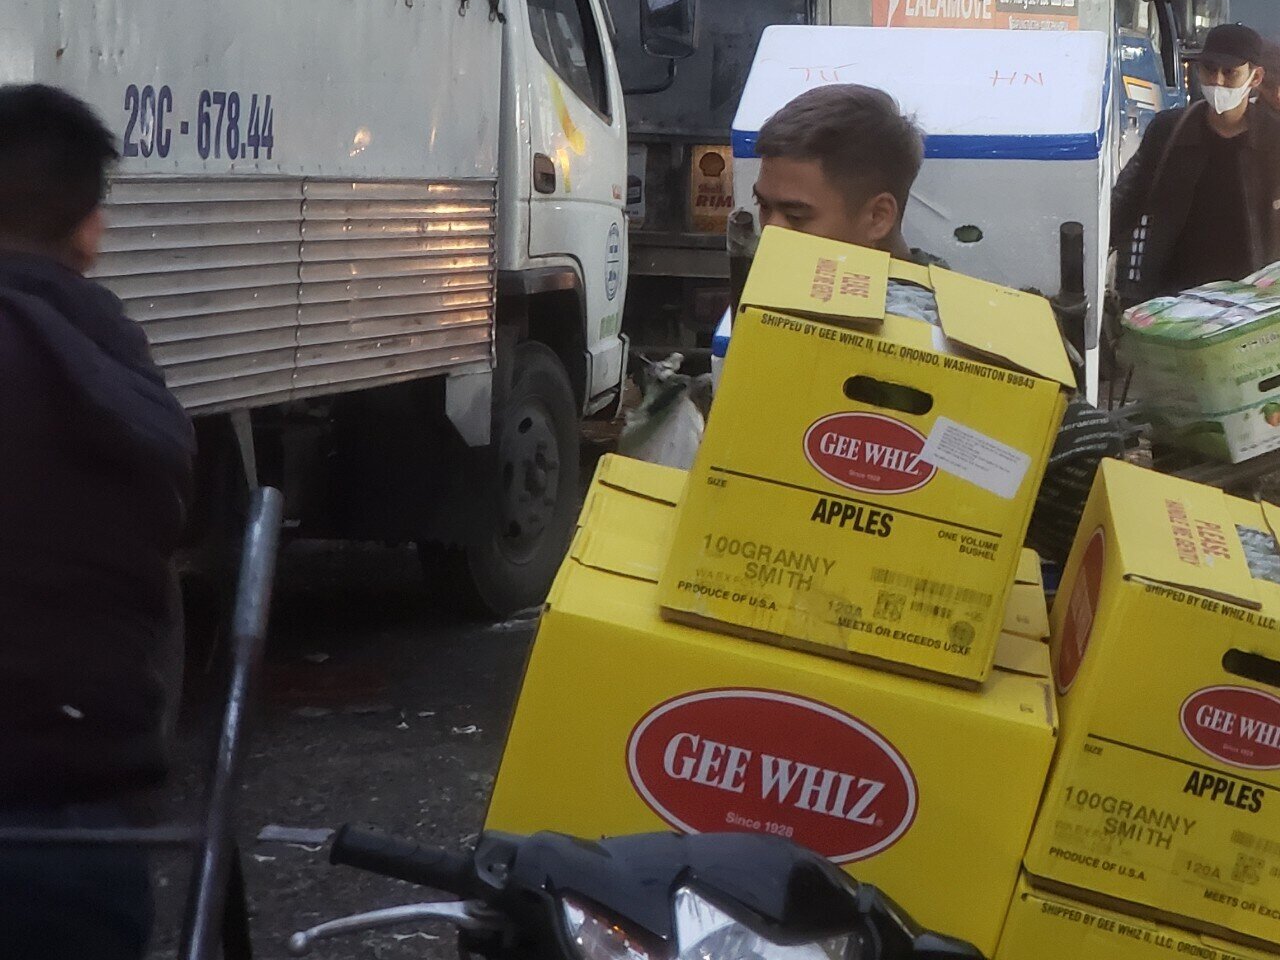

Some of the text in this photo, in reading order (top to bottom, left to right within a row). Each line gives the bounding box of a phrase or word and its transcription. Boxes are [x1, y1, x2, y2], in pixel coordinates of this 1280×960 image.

[197, 89, 274, 160] 678.44
[761, 313, 803, 332] SHIPPED
[804, 324, 818, 336] BY
[819, 327, 838, 341] GEE
[840, 332, 864, 348] WHIZ
[943, 356, 1007, 383] WASHINGTON
[819, 431, 862, 462] GEE
[864, 441, 922, 476] WHIZ
[707, 476, 728, 488] SIZE
[810, 498, 895, 538] APPLES
[703, 533, 837, 576] 100GRANNY
[937, 530, 999, 552] ONE VOLUME
[958, 544, 997, 561] BUSHEL
[677, 580, 730, 600] PRODUCE
[731, 592, 747, 603] OF
[744, 561, 814, 591] SMITH
[1145, 584, 1186, 603] SHIPPED
[1186, 595, 1200, 607] BY
[1201, 599, 1220, 613] GEE
[1222, 604, 1245, 621] WHIZ
[837, 617, 872, 634] MEETS
[874, 626, 891, 638] OR
[892, 630, 941, 649] EXCEEDS
[1195, 704, 1238, 735] GEE
[663, 732, 886, 825] GEE WHIZ
[1183, 770, 1265, 814] APPLES
[725, 811, 794, 838] Since 1928
[1065, 786, 1197, 836] 100GRANNY
[1103, 817, 1173, 850] SMITH
[1049, 846, 1101, 869] PRODUCE
[1101, 861, 1117, 872] OF
[1203, 890, 1240, 908] MEETS
[1240, 899, 1257, 912] OR
[1041, 902, 1082, 922] SHIPPED
[1083, 913, 1097, 926] BY
[1097, 917, 1116, 932] GEE
[1118, 923, 1142, 940] WHIZ
